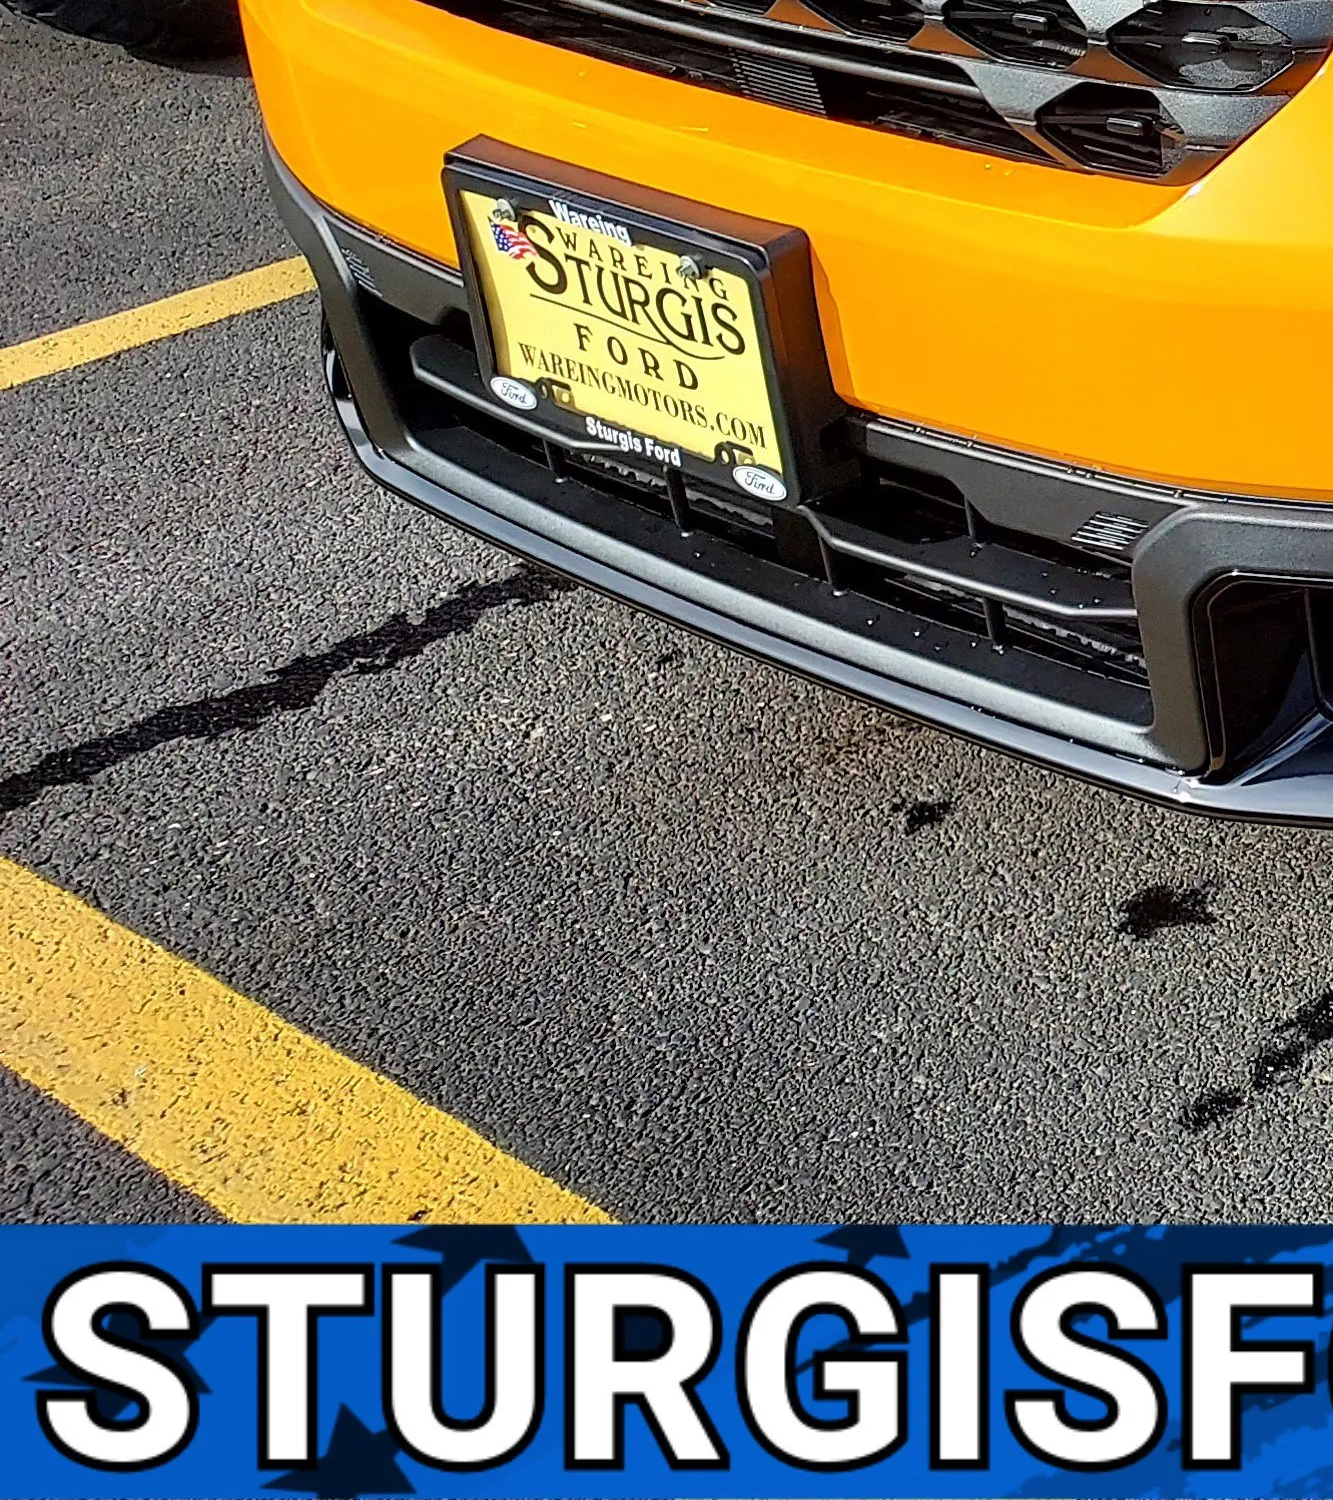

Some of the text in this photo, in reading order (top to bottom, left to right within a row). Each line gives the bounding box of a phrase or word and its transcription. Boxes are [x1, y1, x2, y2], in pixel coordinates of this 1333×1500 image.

[549, 200, 630, 246] Wareing
[519, 215, 746, 360] STURGIS
[573, 323, 699, 391] FORD
[499, 381, 527, 406] Ford
[518, 341, 768, 450] WAREINGMOTORS.COM
[585, 417, 682, 468] Sturgis Ford
[744, 470, 776, 496] Ford
